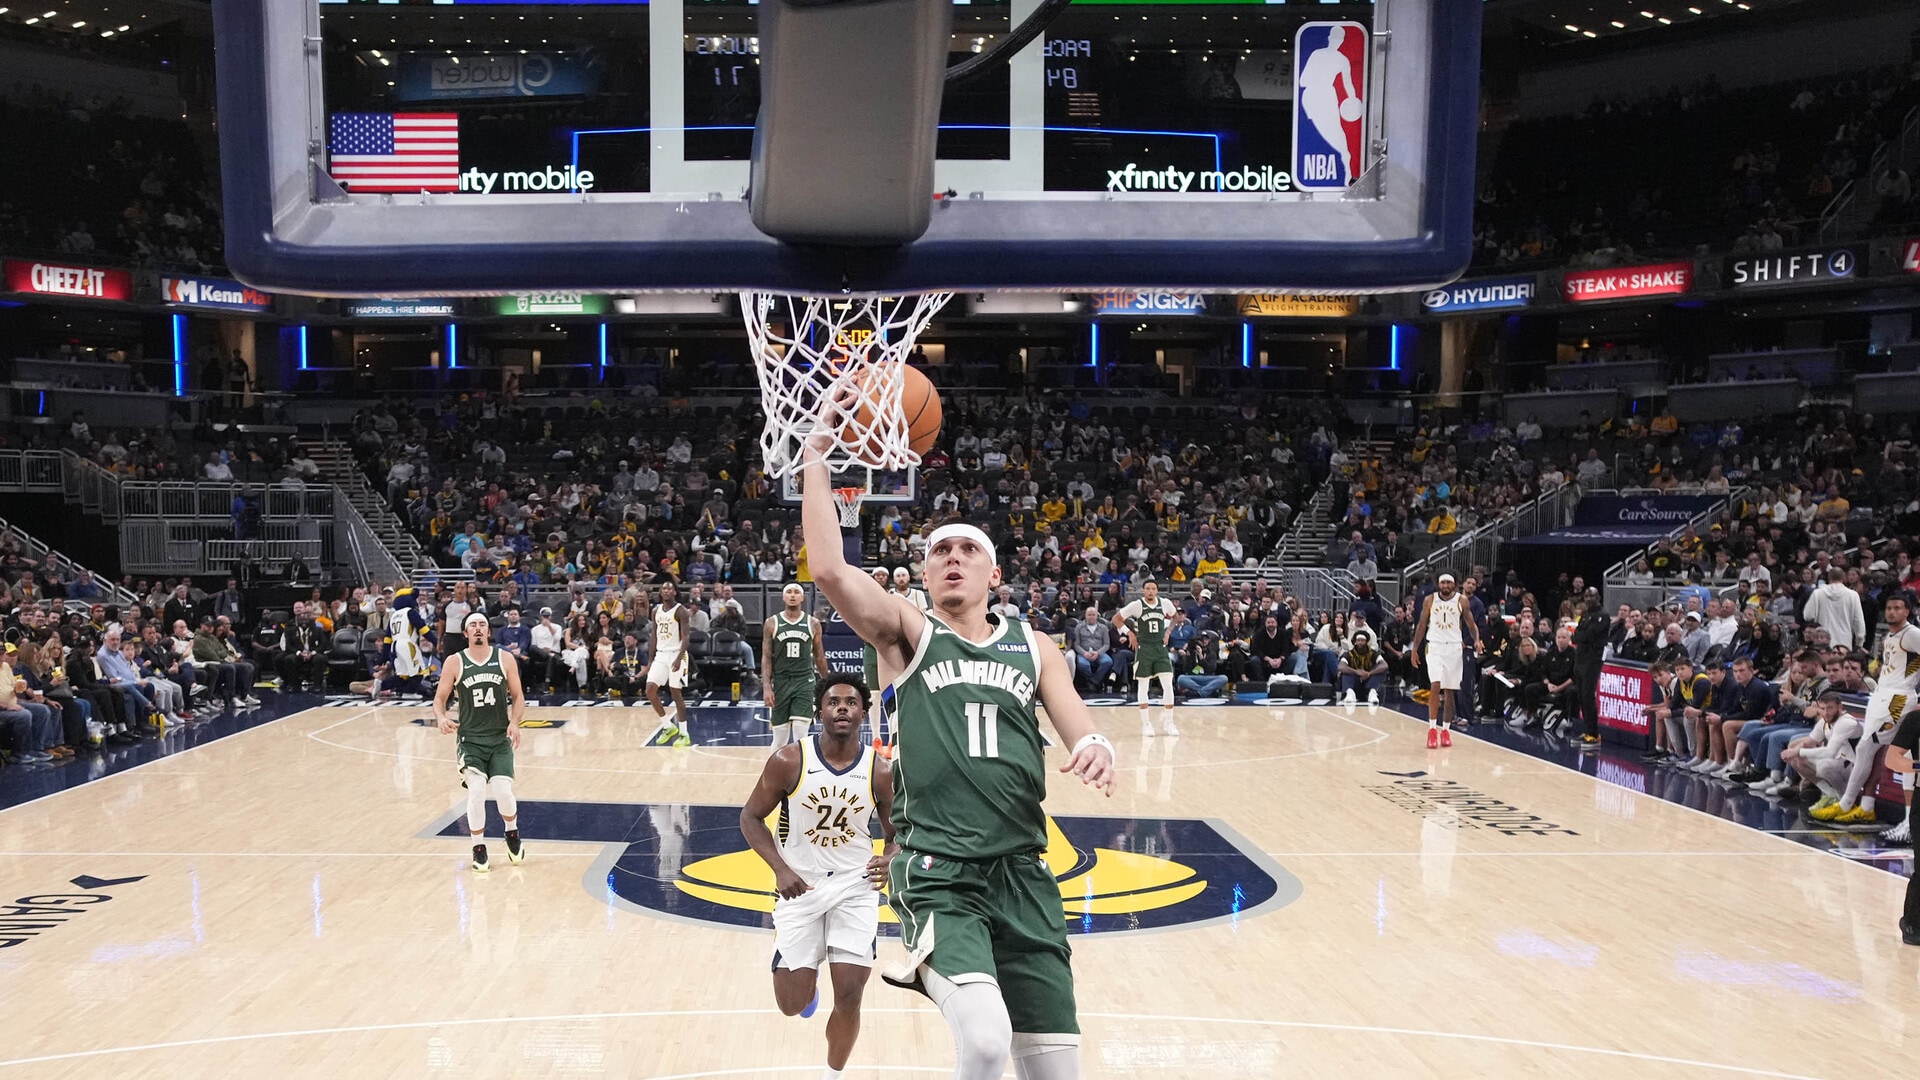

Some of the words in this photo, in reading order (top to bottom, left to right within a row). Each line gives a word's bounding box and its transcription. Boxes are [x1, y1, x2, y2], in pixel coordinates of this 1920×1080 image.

[1303, 153, 1338, 181] NBA
[503, 165, 594, 191] mobile
[1107, 163, 1195, 193] xfinity
[1200, 164, 1291, 191] mobile
[1733, 254, 1823, 283] SHIFT
[1567, 275, 1617, 295] STEAK
[1619, 279, 1628, 288] N
[1630, 270, 1686, 289] SHAKE
[530, 291, 583, 304] RYAN
[1453, 283, 1535, 305] HYUNDAI
[396, 306, 414, 314] HIRE
[1265, 304, 1300, 312] FLIGHT
[1304, 304, 1352, 312] TRAINING
[1619, 507, 1693, 521] CareSource
[1148, 620, 1159, 633] 13
[1443, 612, 1447, 623] 1
[786, 642, 800, 658] 18
[824, 647, 864, 659] scensi
[997, 643, 1029, 653] ULINE
[832, 661, 864, 673] Vinc
[462, 673, 504, 689] MILWAUKEE
[1600, 672, 1626, 697] BRING
[1627, 677, 1641, 700] ON
[472, 687, 497, 708] 24
[964, 702, 999, 758] 11
[801, 785, 865, 815] INDIANA
[816, 804, 848, 832] 24
[804, 828, 856, 848] PACERS
